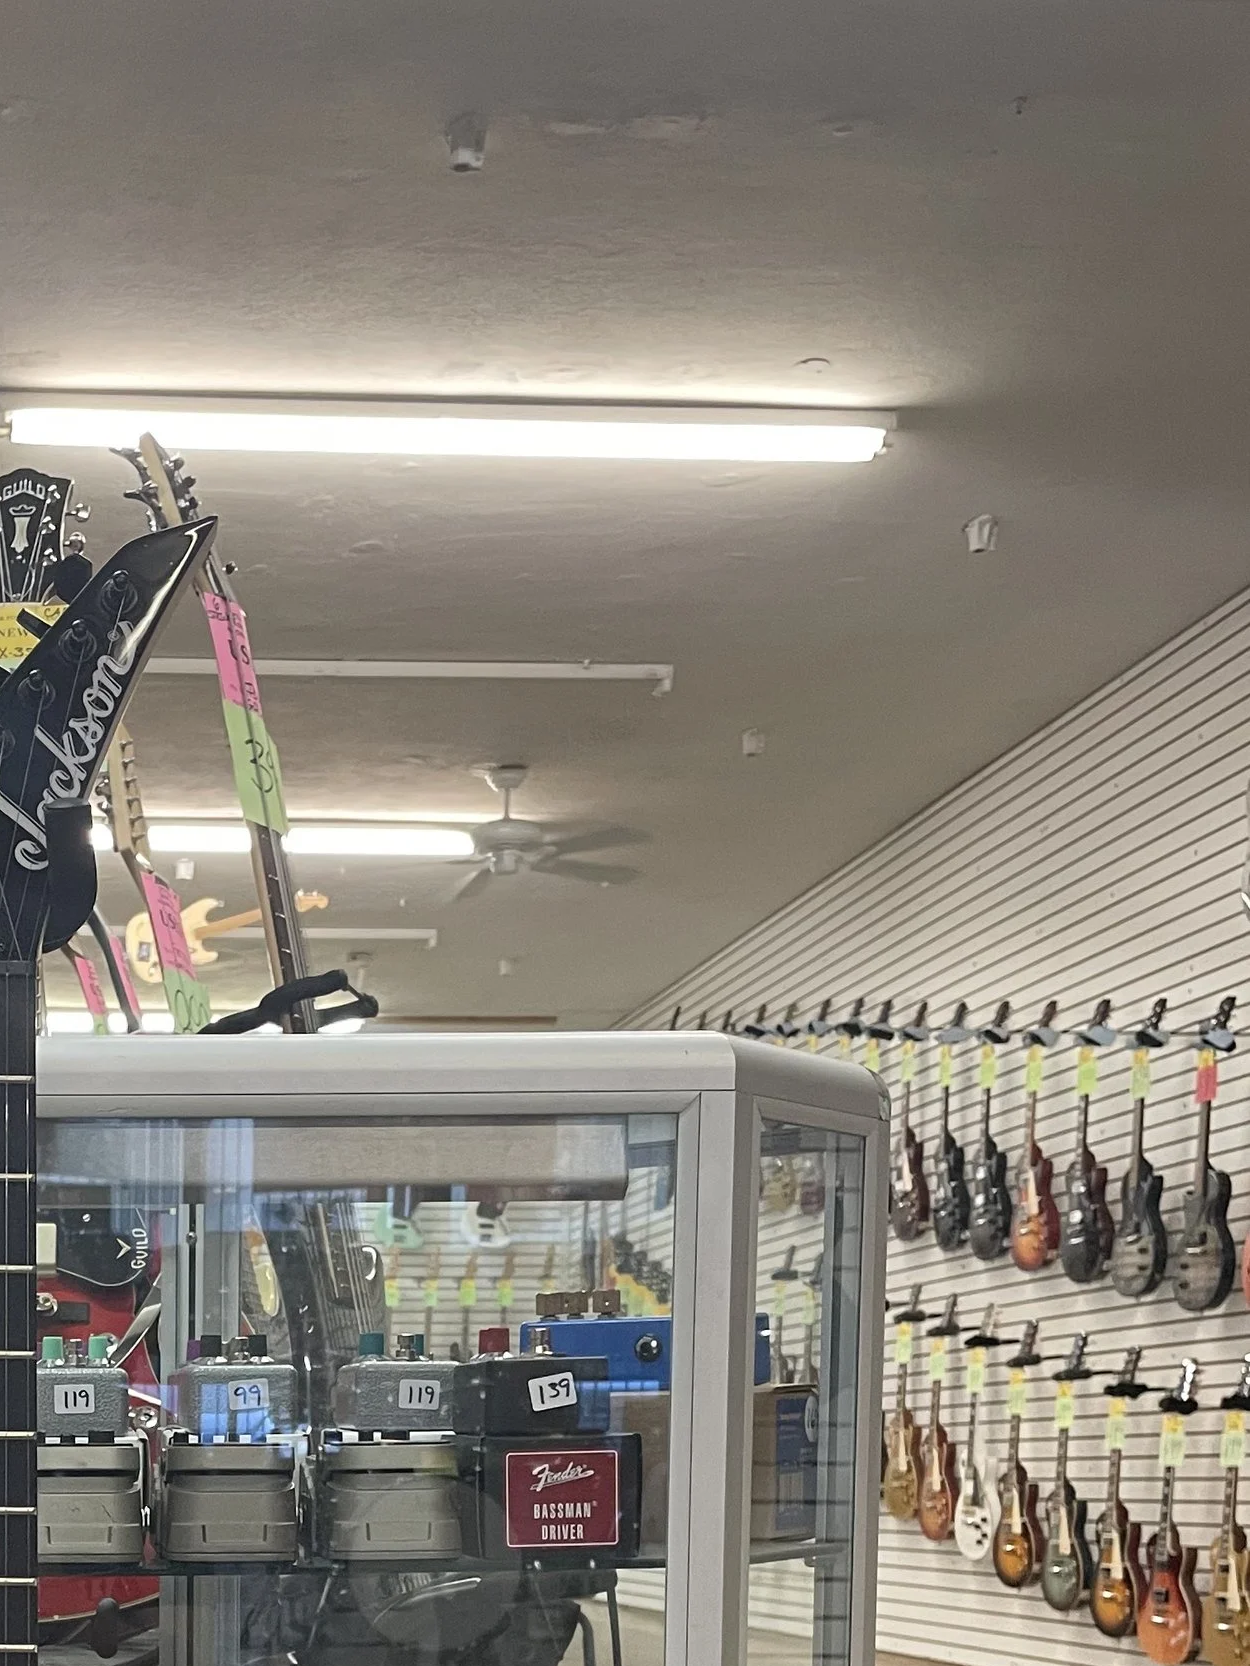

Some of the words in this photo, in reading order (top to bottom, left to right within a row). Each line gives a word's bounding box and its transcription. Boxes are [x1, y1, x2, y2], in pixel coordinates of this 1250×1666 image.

[3, 479, 47, 500] GUILD
[130, 1227, 149, 1270] GUILD
[64, 1389, 90, 1409] 119
[234, 1384, 262, 1406] 99
[408, 1385, 435, 1405] 119
[538, 1378, 571, 1405] 139
[530, 1461, 595, 1492] Fender
[533, 1502, 592, 1520] BASSMAN
[541, 1523, 584, 1541] DRIVER
